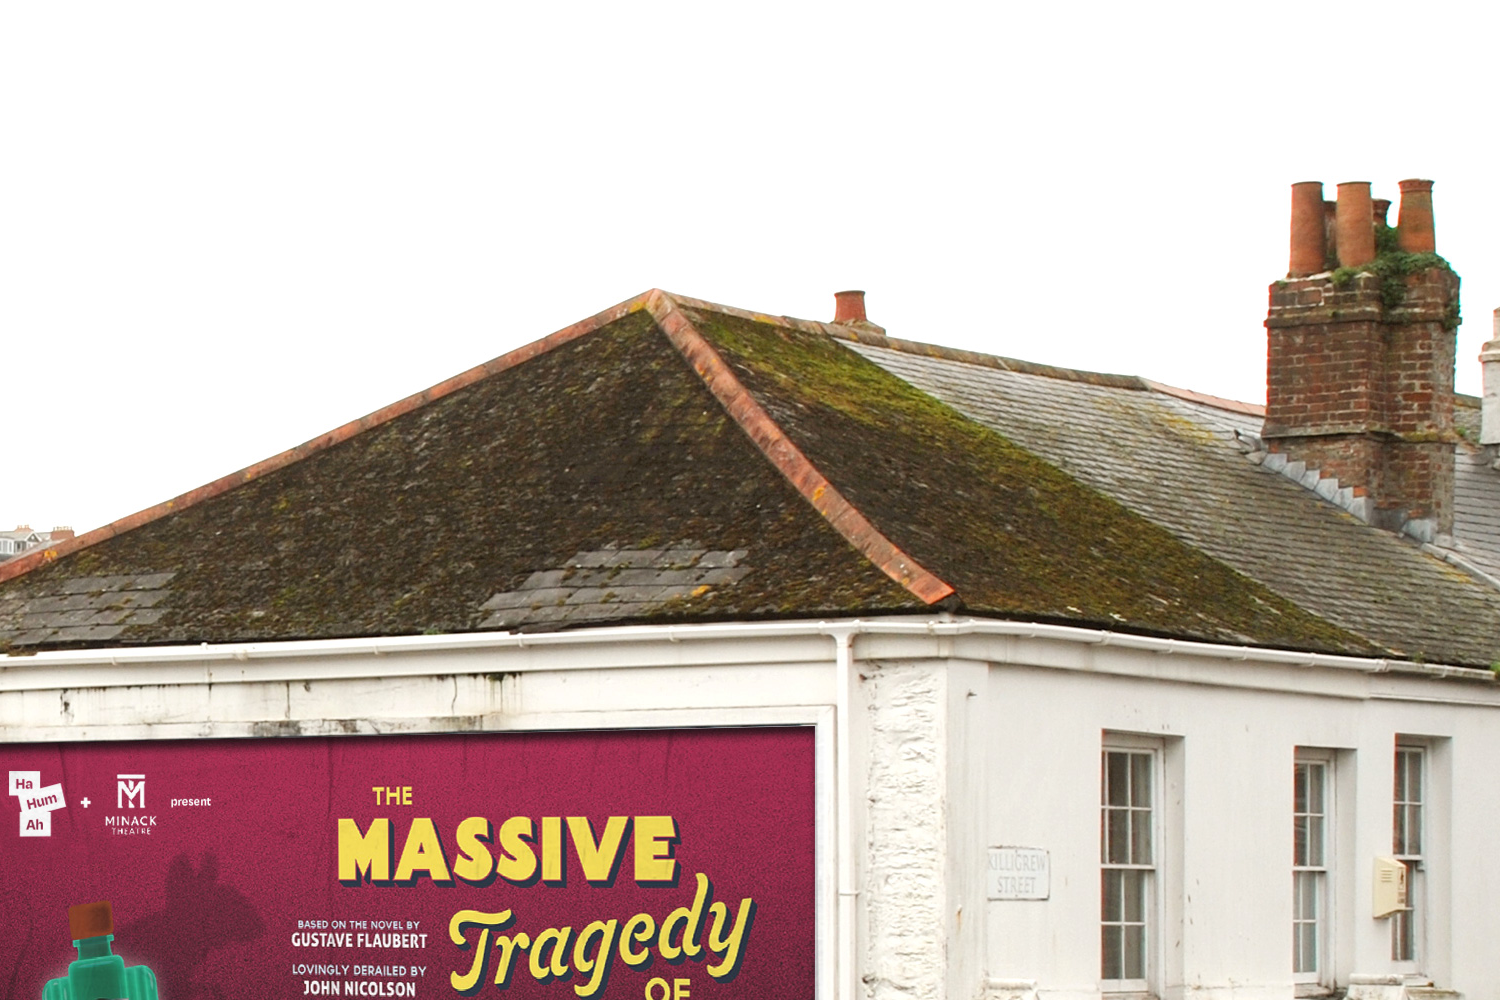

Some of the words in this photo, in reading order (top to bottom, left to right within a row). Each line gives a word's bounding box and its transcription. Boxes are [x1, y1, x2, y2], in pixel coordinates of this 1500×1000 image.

[15, 778, 33, 790] Ha
[26, 793, 58, 810] Hum
[171, 797, 211, 808] present
[373, 786, 413, 806] THE
[26, 818, 44, 830] Ah
[105, 815, 157, 826] MINACK
[111, 827, 151, 835] THEATRE
[337, 815, 681, 888] MASSIVE
[998, 876, 1036, 893] STREET
[298, 920, 329, 930] BASED
[331, 920, 347, 930] ON
[350, 921, 367, 930] THE
[371, 921, 404, 930] NOVEL
[407, 921, 420, 931] BY
[291, 932, 353, 948] GUSTAVE
[357, 933, 428, 949] FLAUBERT
[449, 872, 756, 999] Tragedy
[292, 964, 350, 976] LOVINGLY
[353, 965, 407, 976] DERAILED
[410, 966, 427, 977] BY
[303, 980, 341, 996] JOHN
[344, 981, 416, 997] NICOLSON
